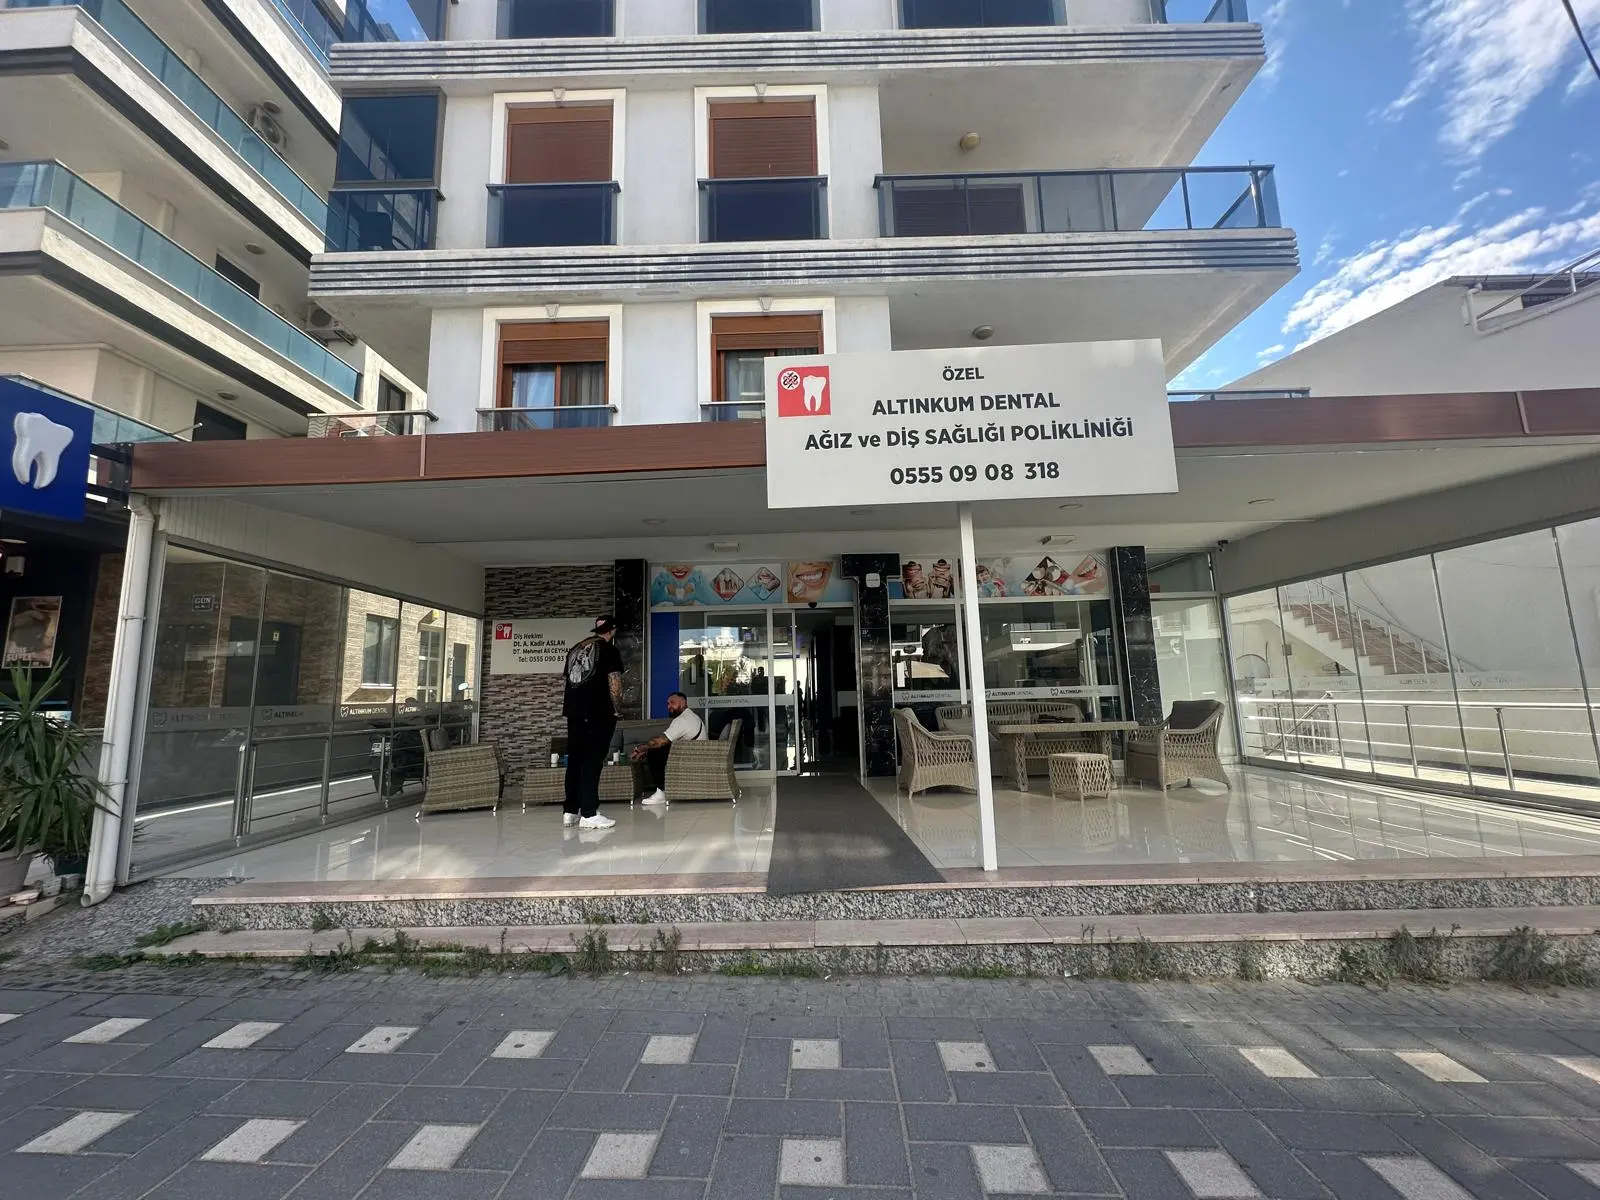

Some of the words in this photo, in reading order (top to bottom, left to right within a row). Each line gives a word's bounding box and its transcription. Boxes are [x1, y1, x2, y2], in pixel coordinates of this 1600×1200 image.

[942, 365, 985, 382] ÖZEL
[872, 396, 975, 416] ALTINKUM
[980, 392, 1061, 411] DENTAL
[804, 429, 853, 451] AĞIZ
[857, 435, 881, 449] ve
[886, 426, 921, 450] DİŞ
[925, 422, 1005, 446] SAĞLIĞI
[1010, 417, 1134, 442] POLİKLİNİĞİ
[890, 465, 944, 485] 0555
[949, 464, 978, 483] 09
[984, 463, 1014, 482] 08
[1024, 461, 1060, 480] 318
[349, 707, 372, 715] ALTINKUM
